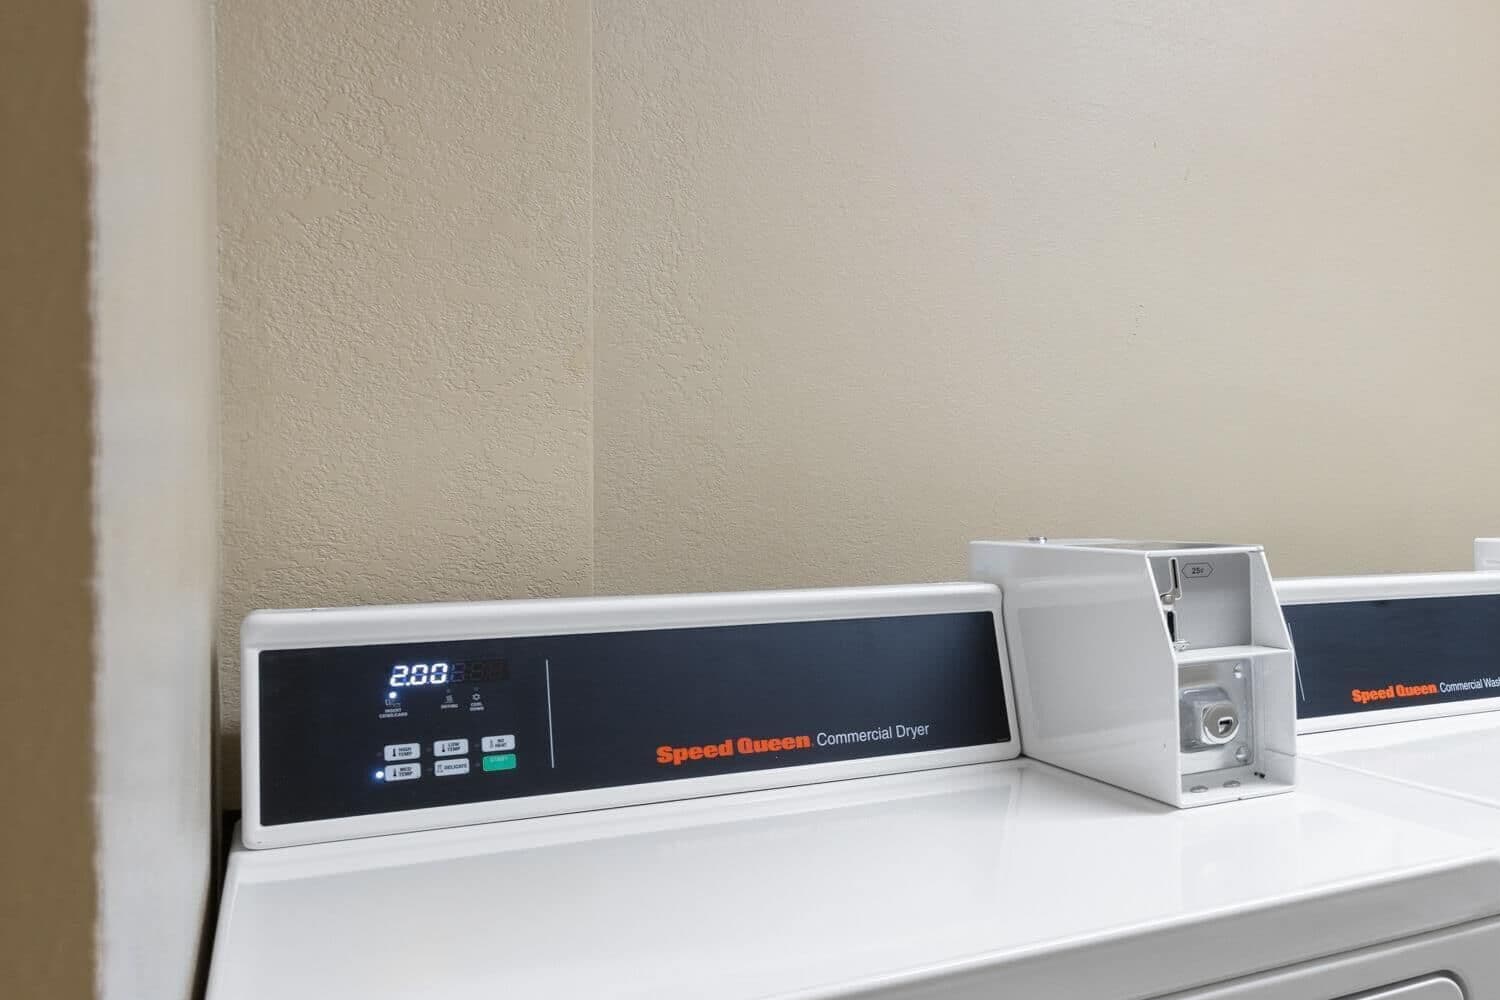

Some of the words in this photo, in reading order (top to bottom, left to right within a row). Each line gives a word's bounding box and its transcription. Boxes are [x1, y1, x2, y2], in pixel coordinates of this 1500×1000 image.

[389, 663, 448, 687] 2.00
[1352, 684, 1395, 703] Speed
[1395, 682, 1438, 698] Queen
[1439, 678, 1483, 693] Commercial
[656, 738, 734, 766] Speed
[737, 734, 812, 755] Queen
[816, 726, 893, 747] Commercial
[896, 723, 930, 739] Dryer
